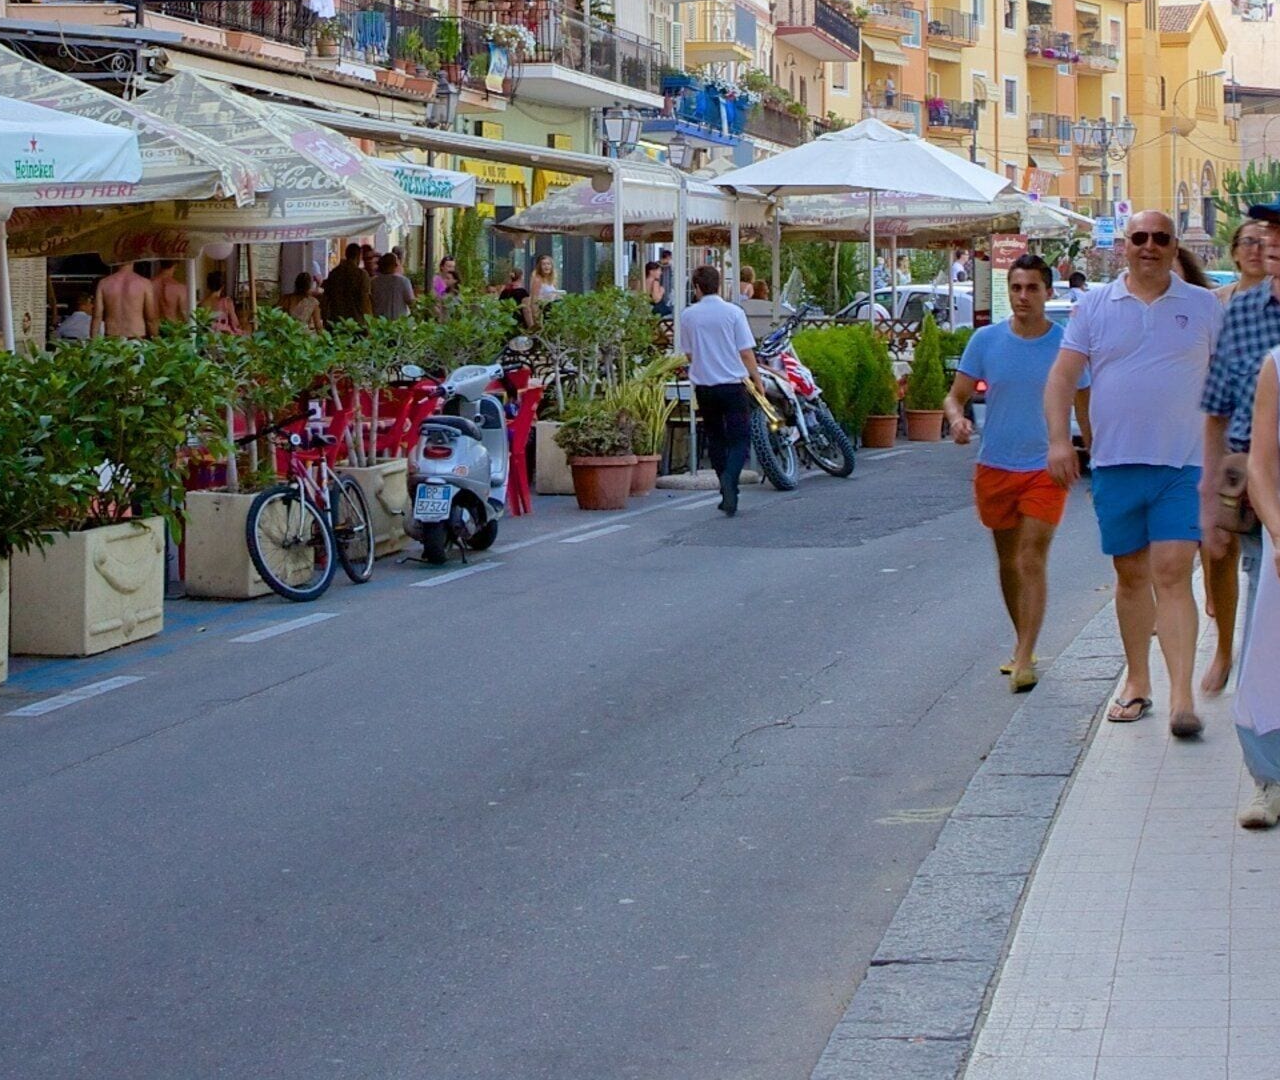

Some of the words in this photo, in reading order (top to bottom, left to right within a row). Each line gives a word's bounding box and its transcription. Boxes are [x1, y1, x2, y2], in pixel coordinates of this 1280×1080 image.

[15, 160, 55, 178] Heineken
[34, 185, 86, 200] SOLD
[91, 183, 137, 197] HERE
